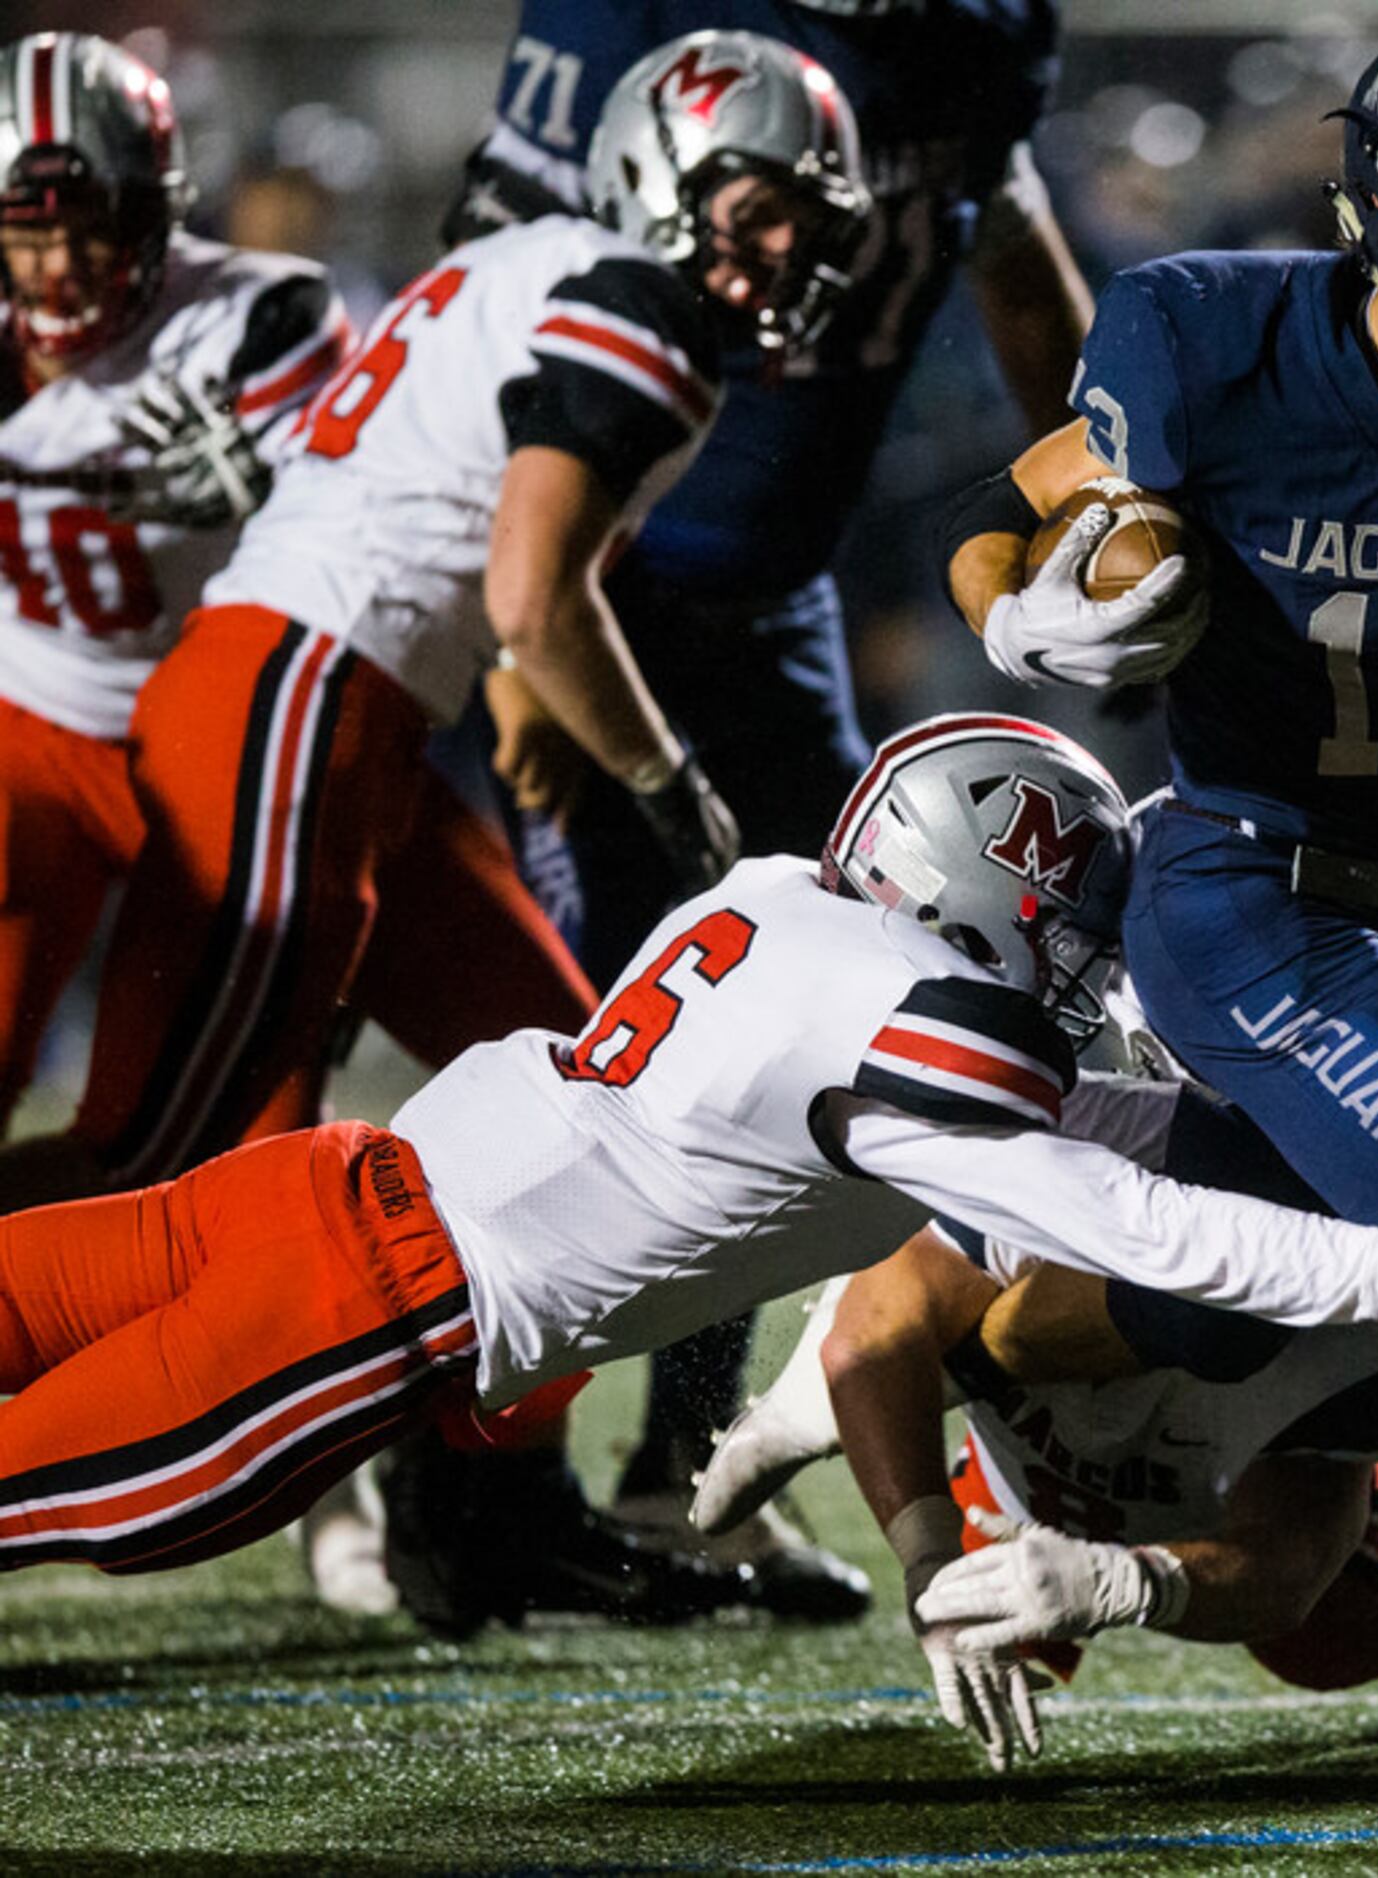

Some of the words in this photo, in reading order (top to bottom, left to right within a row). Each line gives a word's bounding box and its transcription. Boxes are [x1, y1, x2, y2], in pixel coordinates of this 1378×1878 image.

[508, 35, 583, 148] 71
[646, 43, 752, 123] M
[979, 774, 1112, 911] M
[548, 906, 760, 1090] 6
